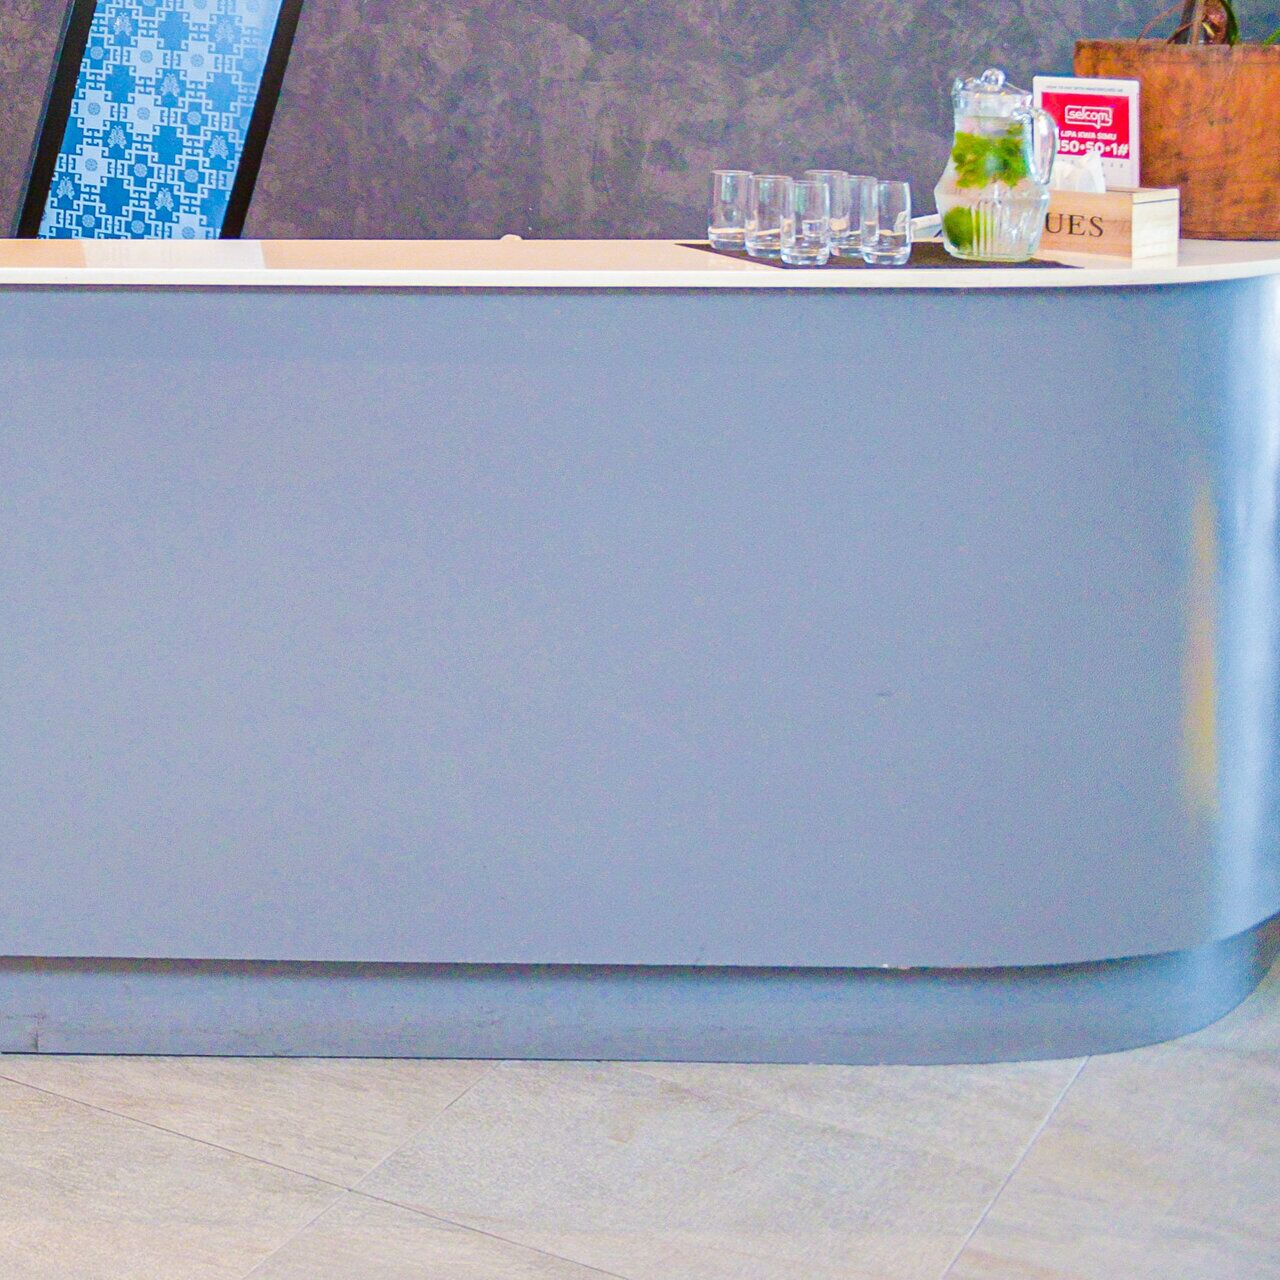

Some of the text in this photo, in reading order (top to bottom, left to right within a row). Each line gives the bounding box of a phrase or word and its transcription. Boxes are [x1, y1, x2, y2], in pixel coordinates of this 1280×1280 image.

[1067, 107, 1111, 123] selcom
[1078, 131, 1096, 139] KWA
[1045, 212, 1104, 238] UES
